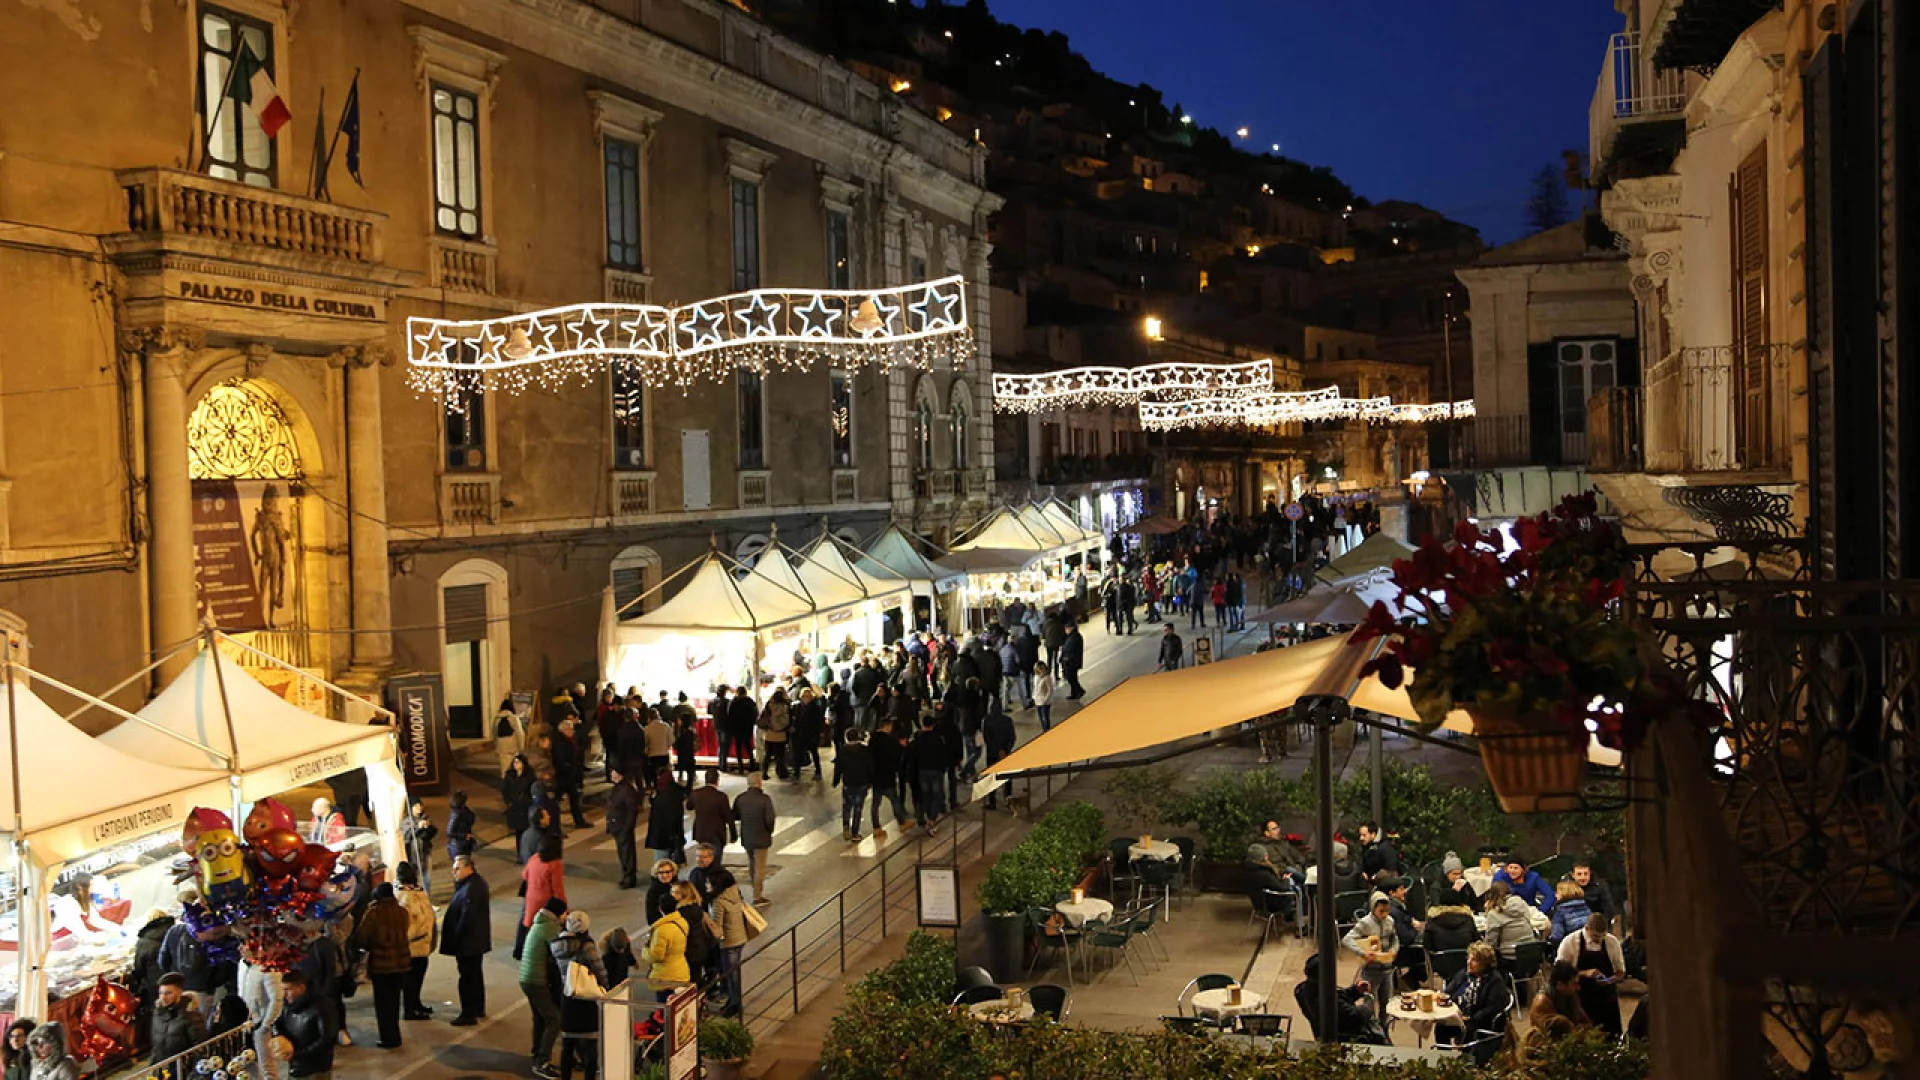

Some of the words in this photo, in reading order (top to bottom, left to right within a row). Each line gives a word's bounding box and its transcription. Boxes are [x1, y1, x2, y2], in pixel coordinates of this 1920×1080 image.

[180, 281, 255, 303] PALAZZO
[261, 291, 308, 310] DELLA
[314, 299, 376, 318] CULTURA
[408, 696, 428, 776] CHOCOMODICA
